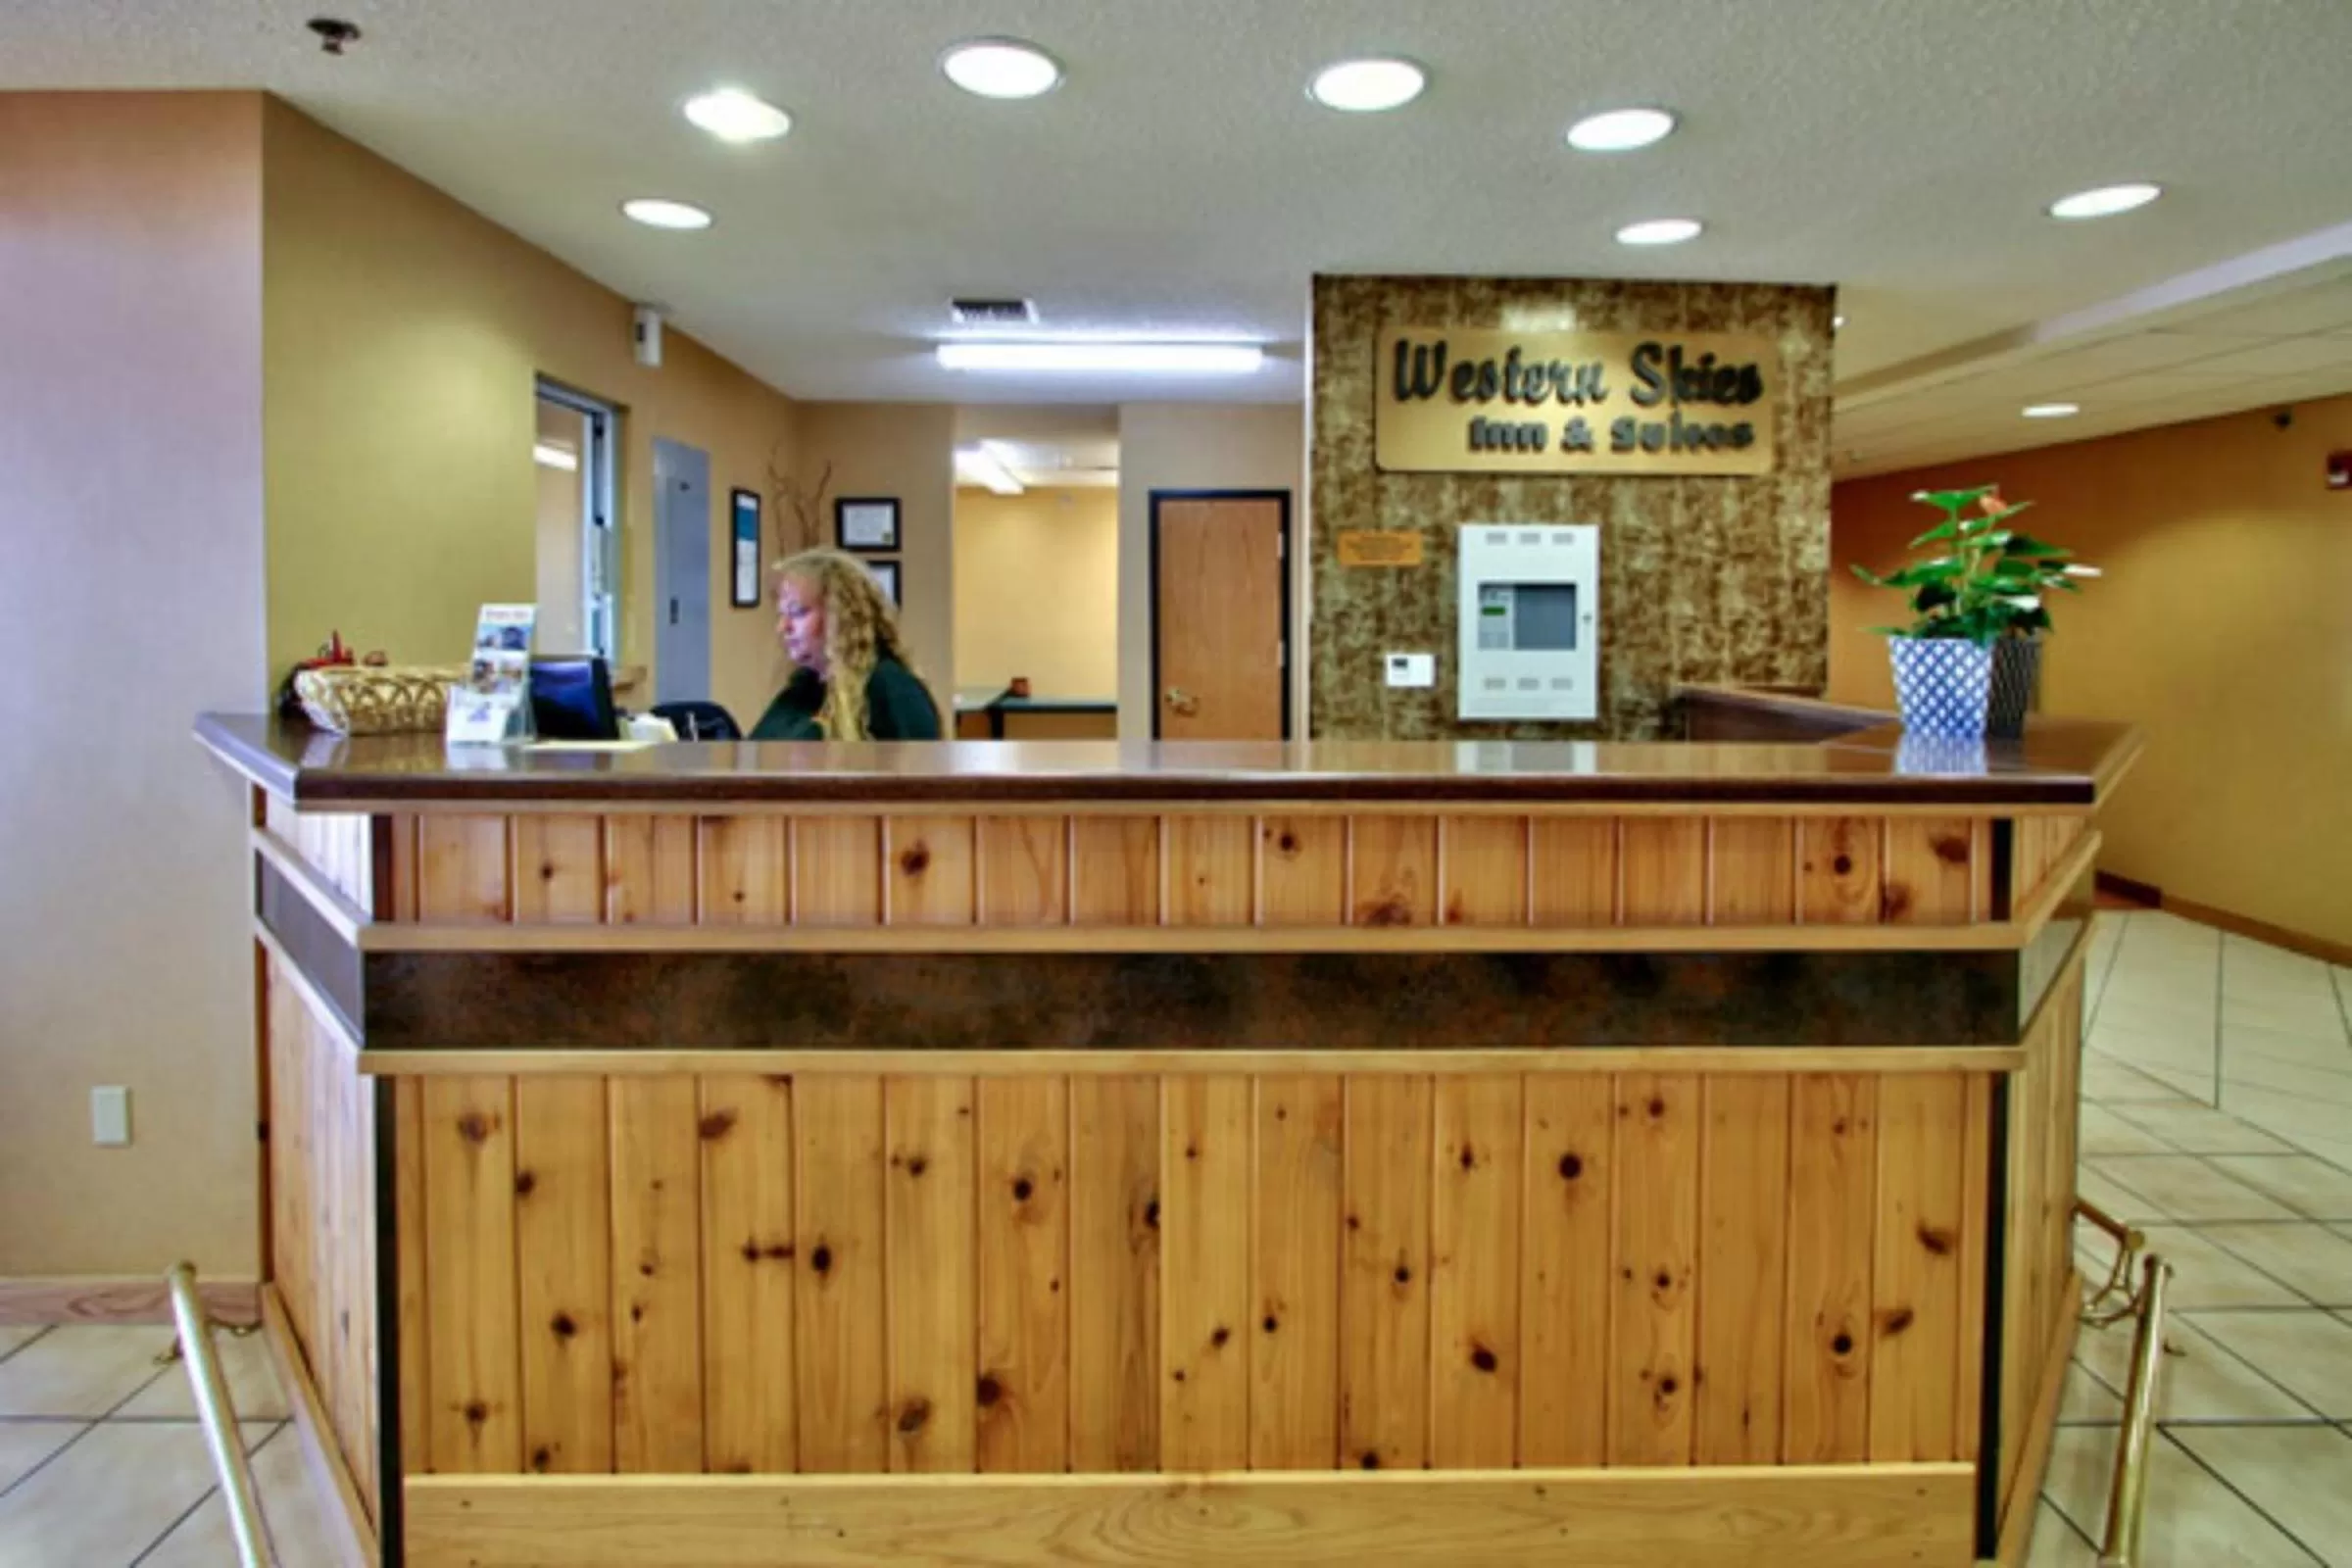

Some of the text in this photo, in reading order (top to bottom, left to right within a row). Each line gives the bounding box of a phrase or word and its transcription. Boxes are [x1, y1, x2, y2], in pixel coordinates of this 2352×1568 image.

[1394, 338, 1765, 408] Western Skies
[1468, 416, 1548, 453] Inn
[1560, 417, 1595, 453] &
